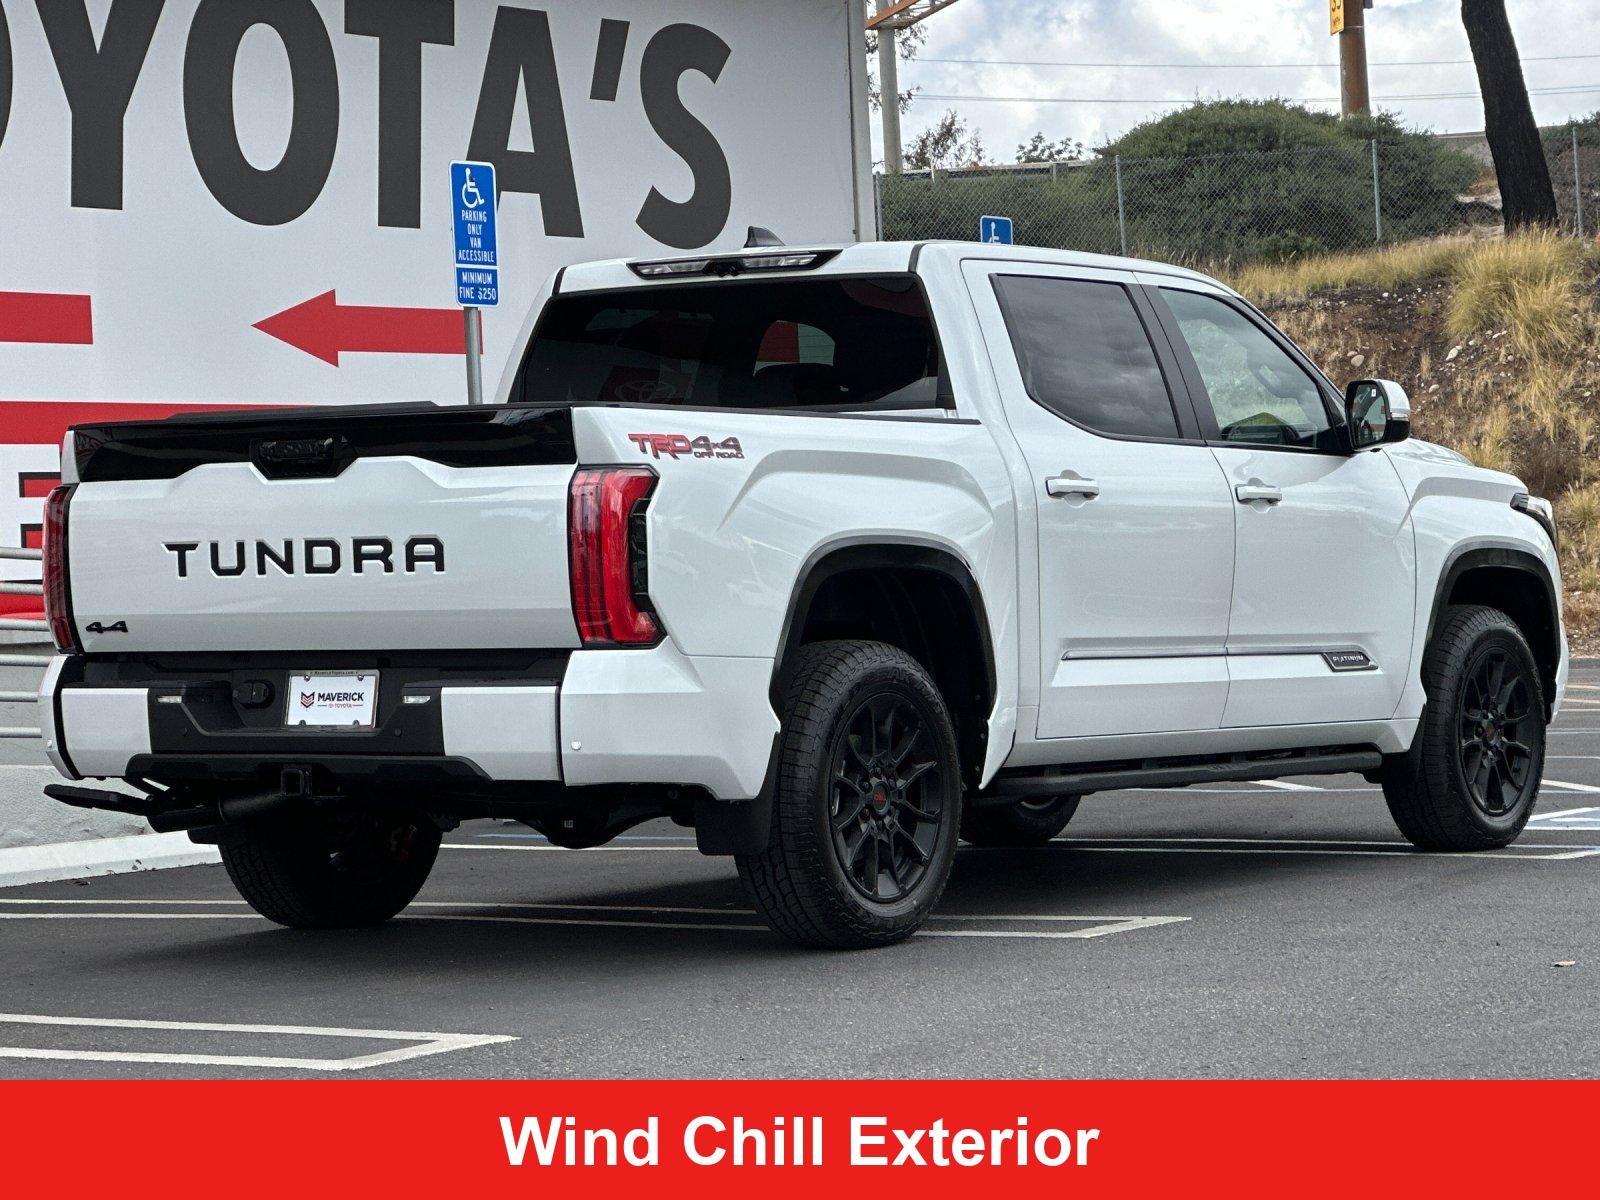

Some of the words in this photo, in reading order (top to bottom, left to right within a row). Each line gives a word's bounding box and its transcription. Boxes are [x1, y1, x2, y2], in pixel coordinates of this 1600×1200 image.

[0, 0, 732, 249] YOTA'S
[461, 210, 487, 222] PARKING
[467, 224, 482, 235] ONLY
[469, 237, 482, 249] VAN
[458, 250, 494, 262] ACCESSIBLE
[462, 271, 492, 284] MINIMUM
[459, 286, 475, 299] FINE
[477, 288, 497, 300] $250
[628, 433, 693, 460] TRD
[693, 451, 714, 459] OFF
[715, 451, 744, 459] ROAD
[162, 535, 446, 579] TUNDRA
[317, 692, 364, 702] MAVERICK
